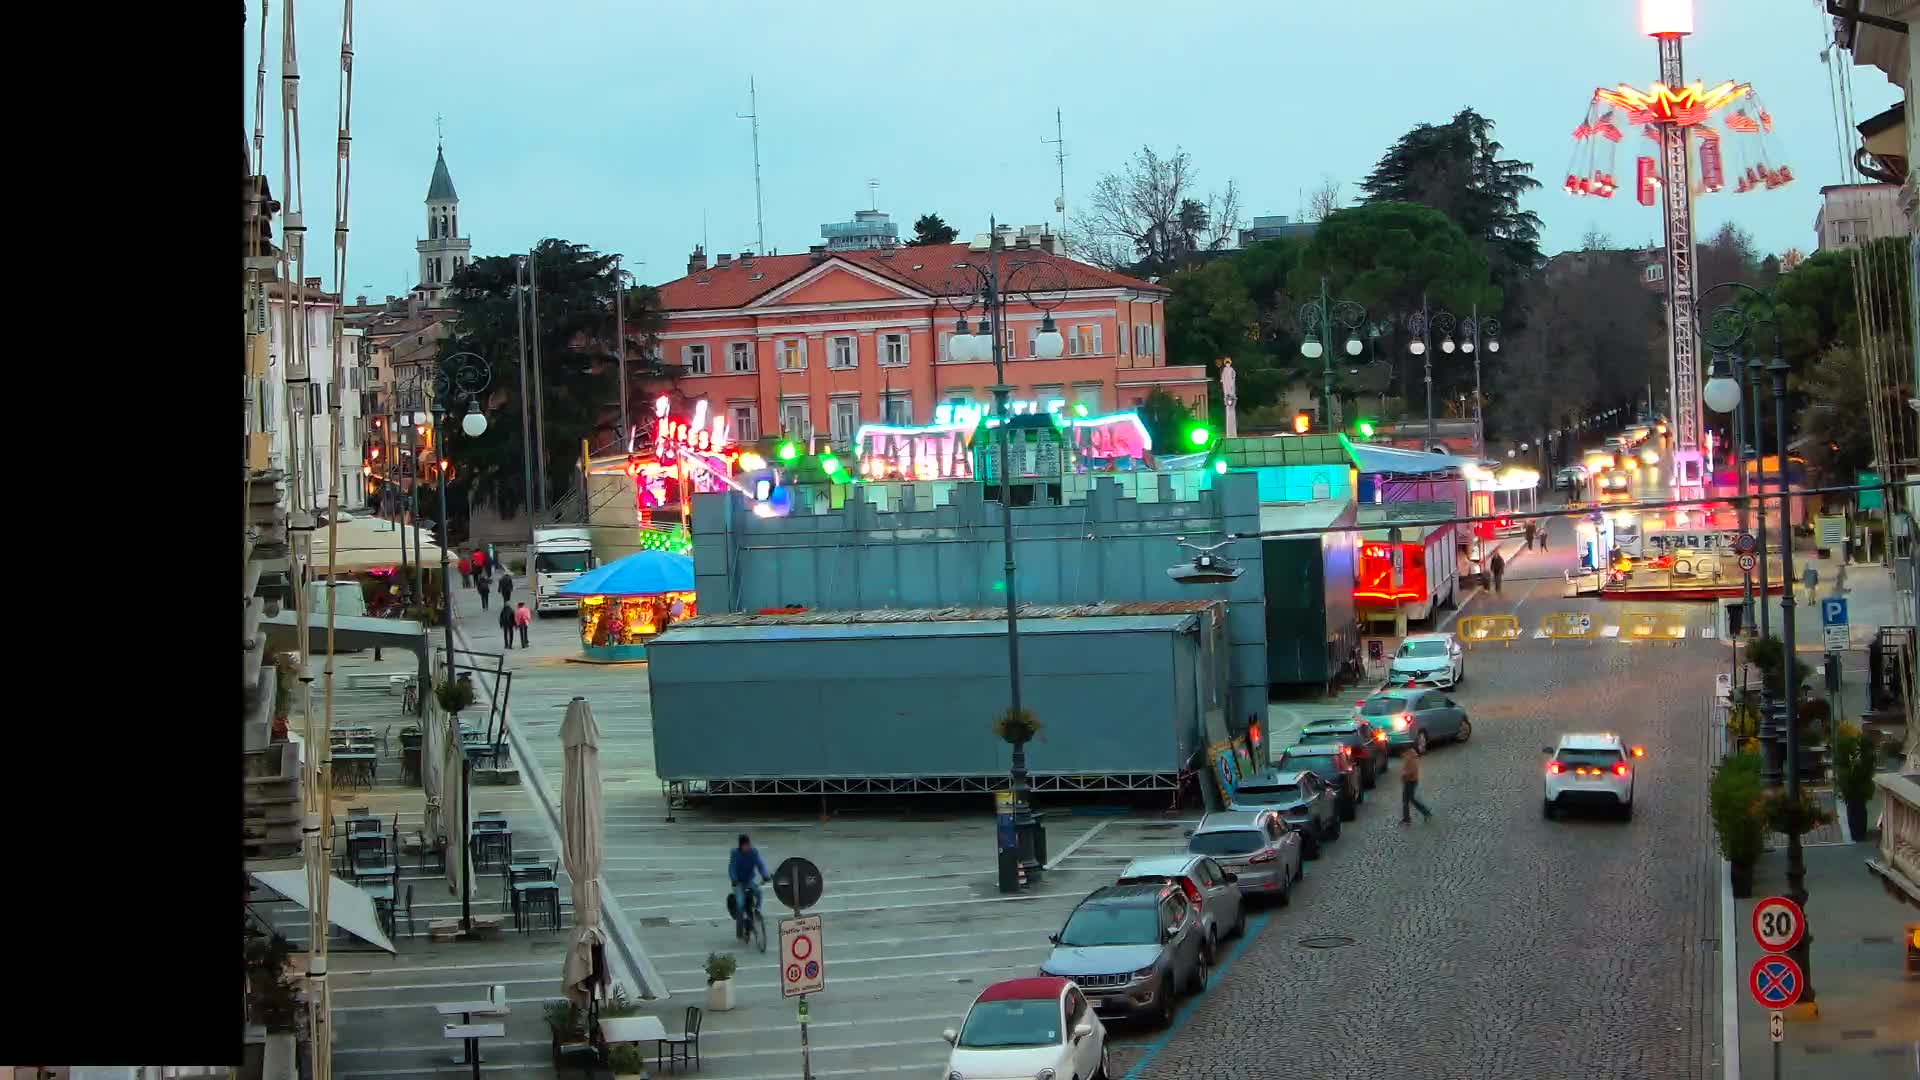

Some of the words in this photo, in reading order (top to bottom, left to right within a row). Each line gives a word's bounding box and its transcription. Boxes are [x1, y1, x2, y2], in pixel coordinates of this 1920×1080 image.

[1742, 558, 1752, 567] 20
[1826, 602, 1842, 621] P
[1762, 912, 1791, 937] 30
